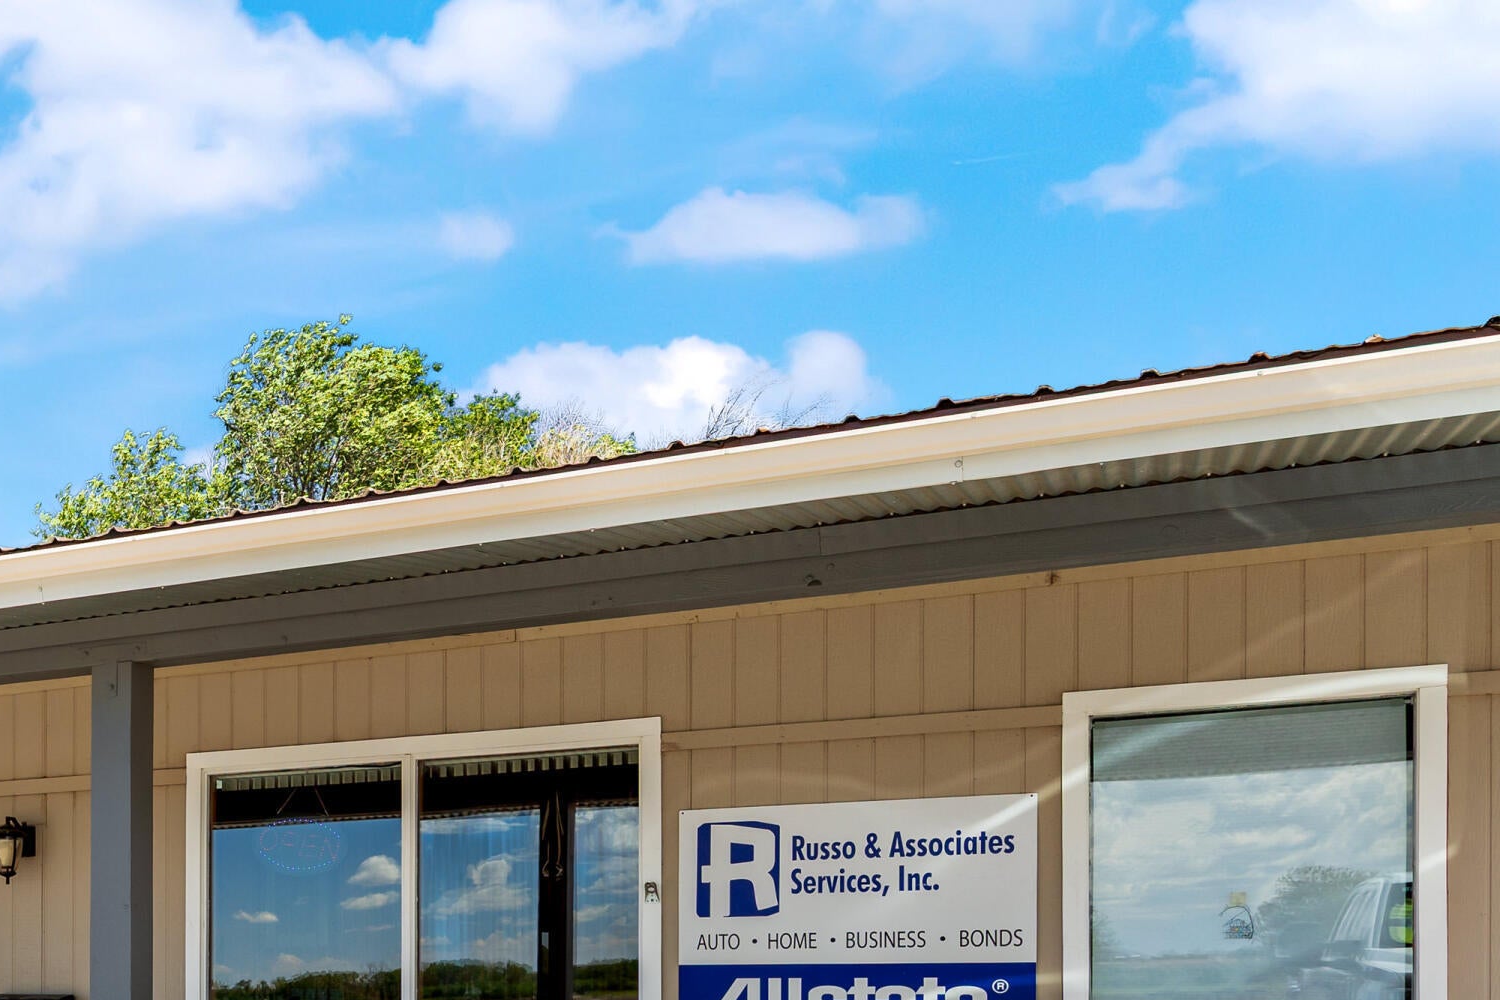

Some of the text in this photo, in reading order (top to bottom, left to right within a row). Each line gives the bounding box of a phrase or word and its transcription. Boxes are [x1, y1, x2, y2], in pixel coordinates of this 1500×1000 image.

[791, 829, 1016, 861] Russo & Associates
[790, 864, 940, 897] Services, Inc.
[696, 928, 1024, 950] AUTO HOME BUSINESS BONDS
